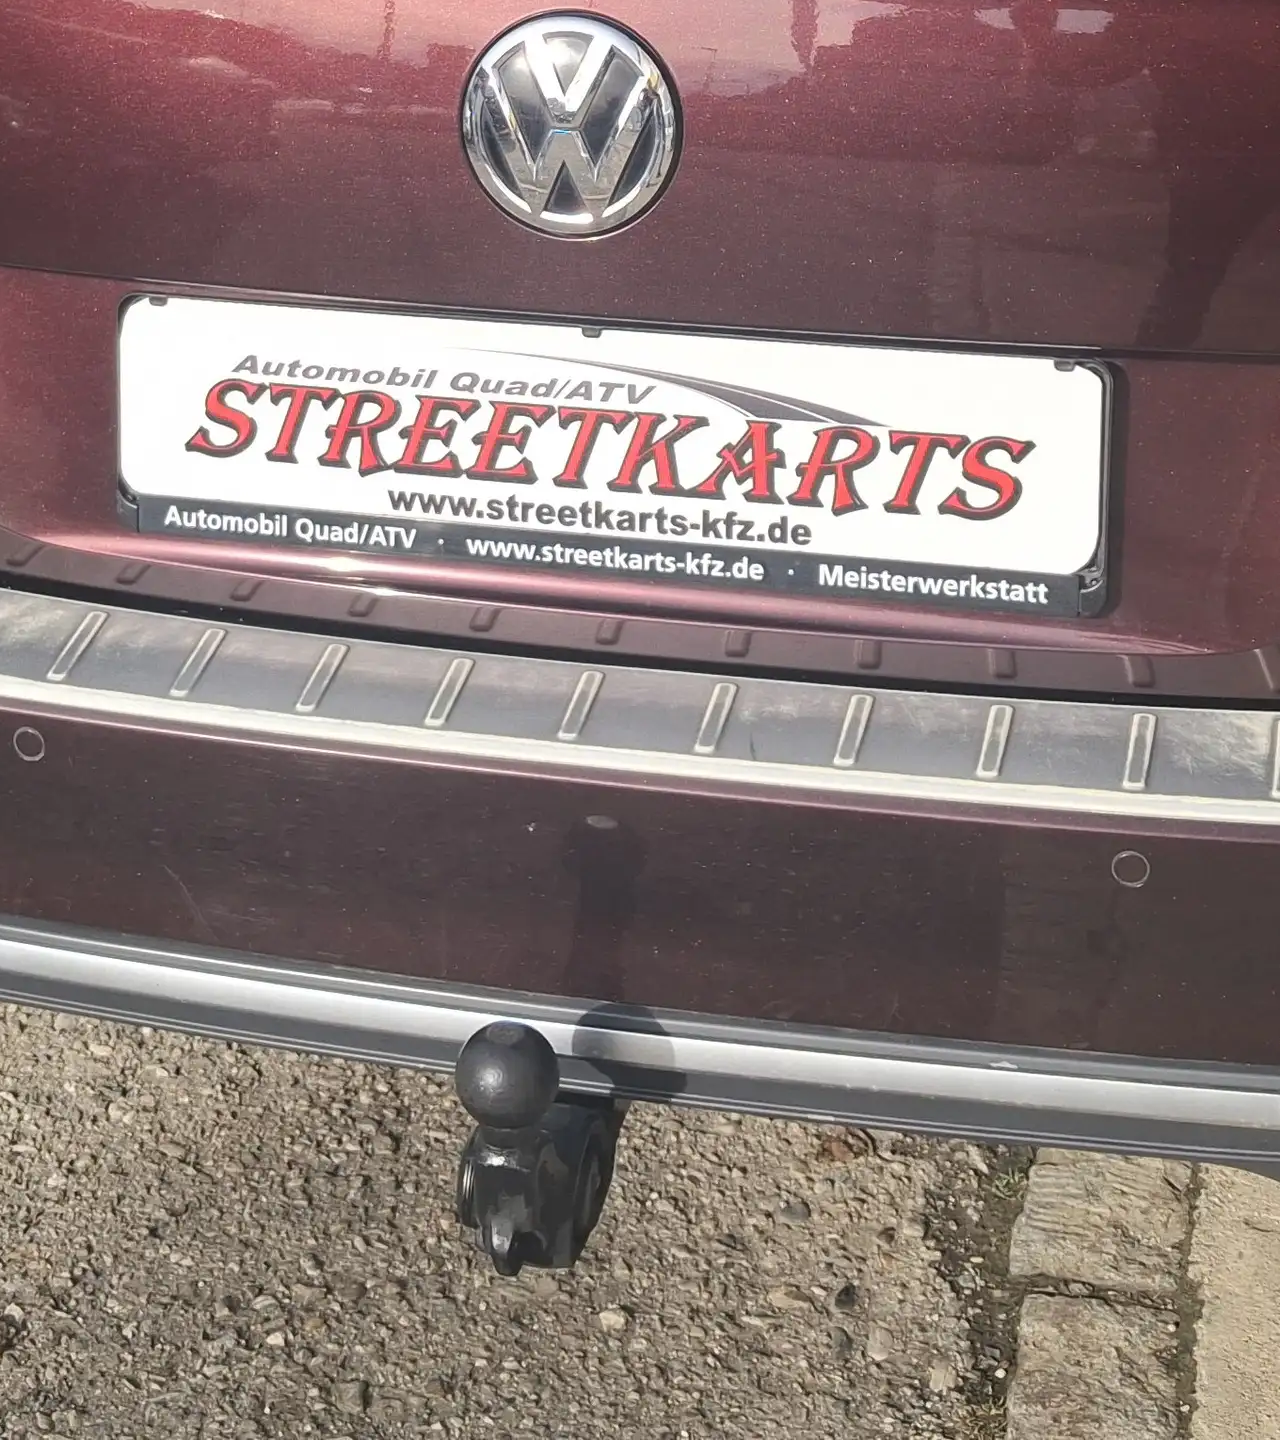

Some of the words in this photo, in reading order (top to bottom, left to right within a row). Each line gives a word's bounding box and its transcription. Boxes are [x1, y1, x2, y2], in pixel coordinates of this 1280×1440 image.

[231, 354, 438, 390] Automobil
[450, 371, 656, 405] Quad/ATV
[185, 378, 1036, 520] STREETKARTS
[164, 505, 288, 538] Automobil
[295, 519, 418, 550] Quad/ATV
[466, 537, 765, 580] www.streetkarts-kfz.de
[818, 563, 1049, 604] Meisterwerkstatt
[388, 489, 812, 545] www.streetkarts-kfz.de
